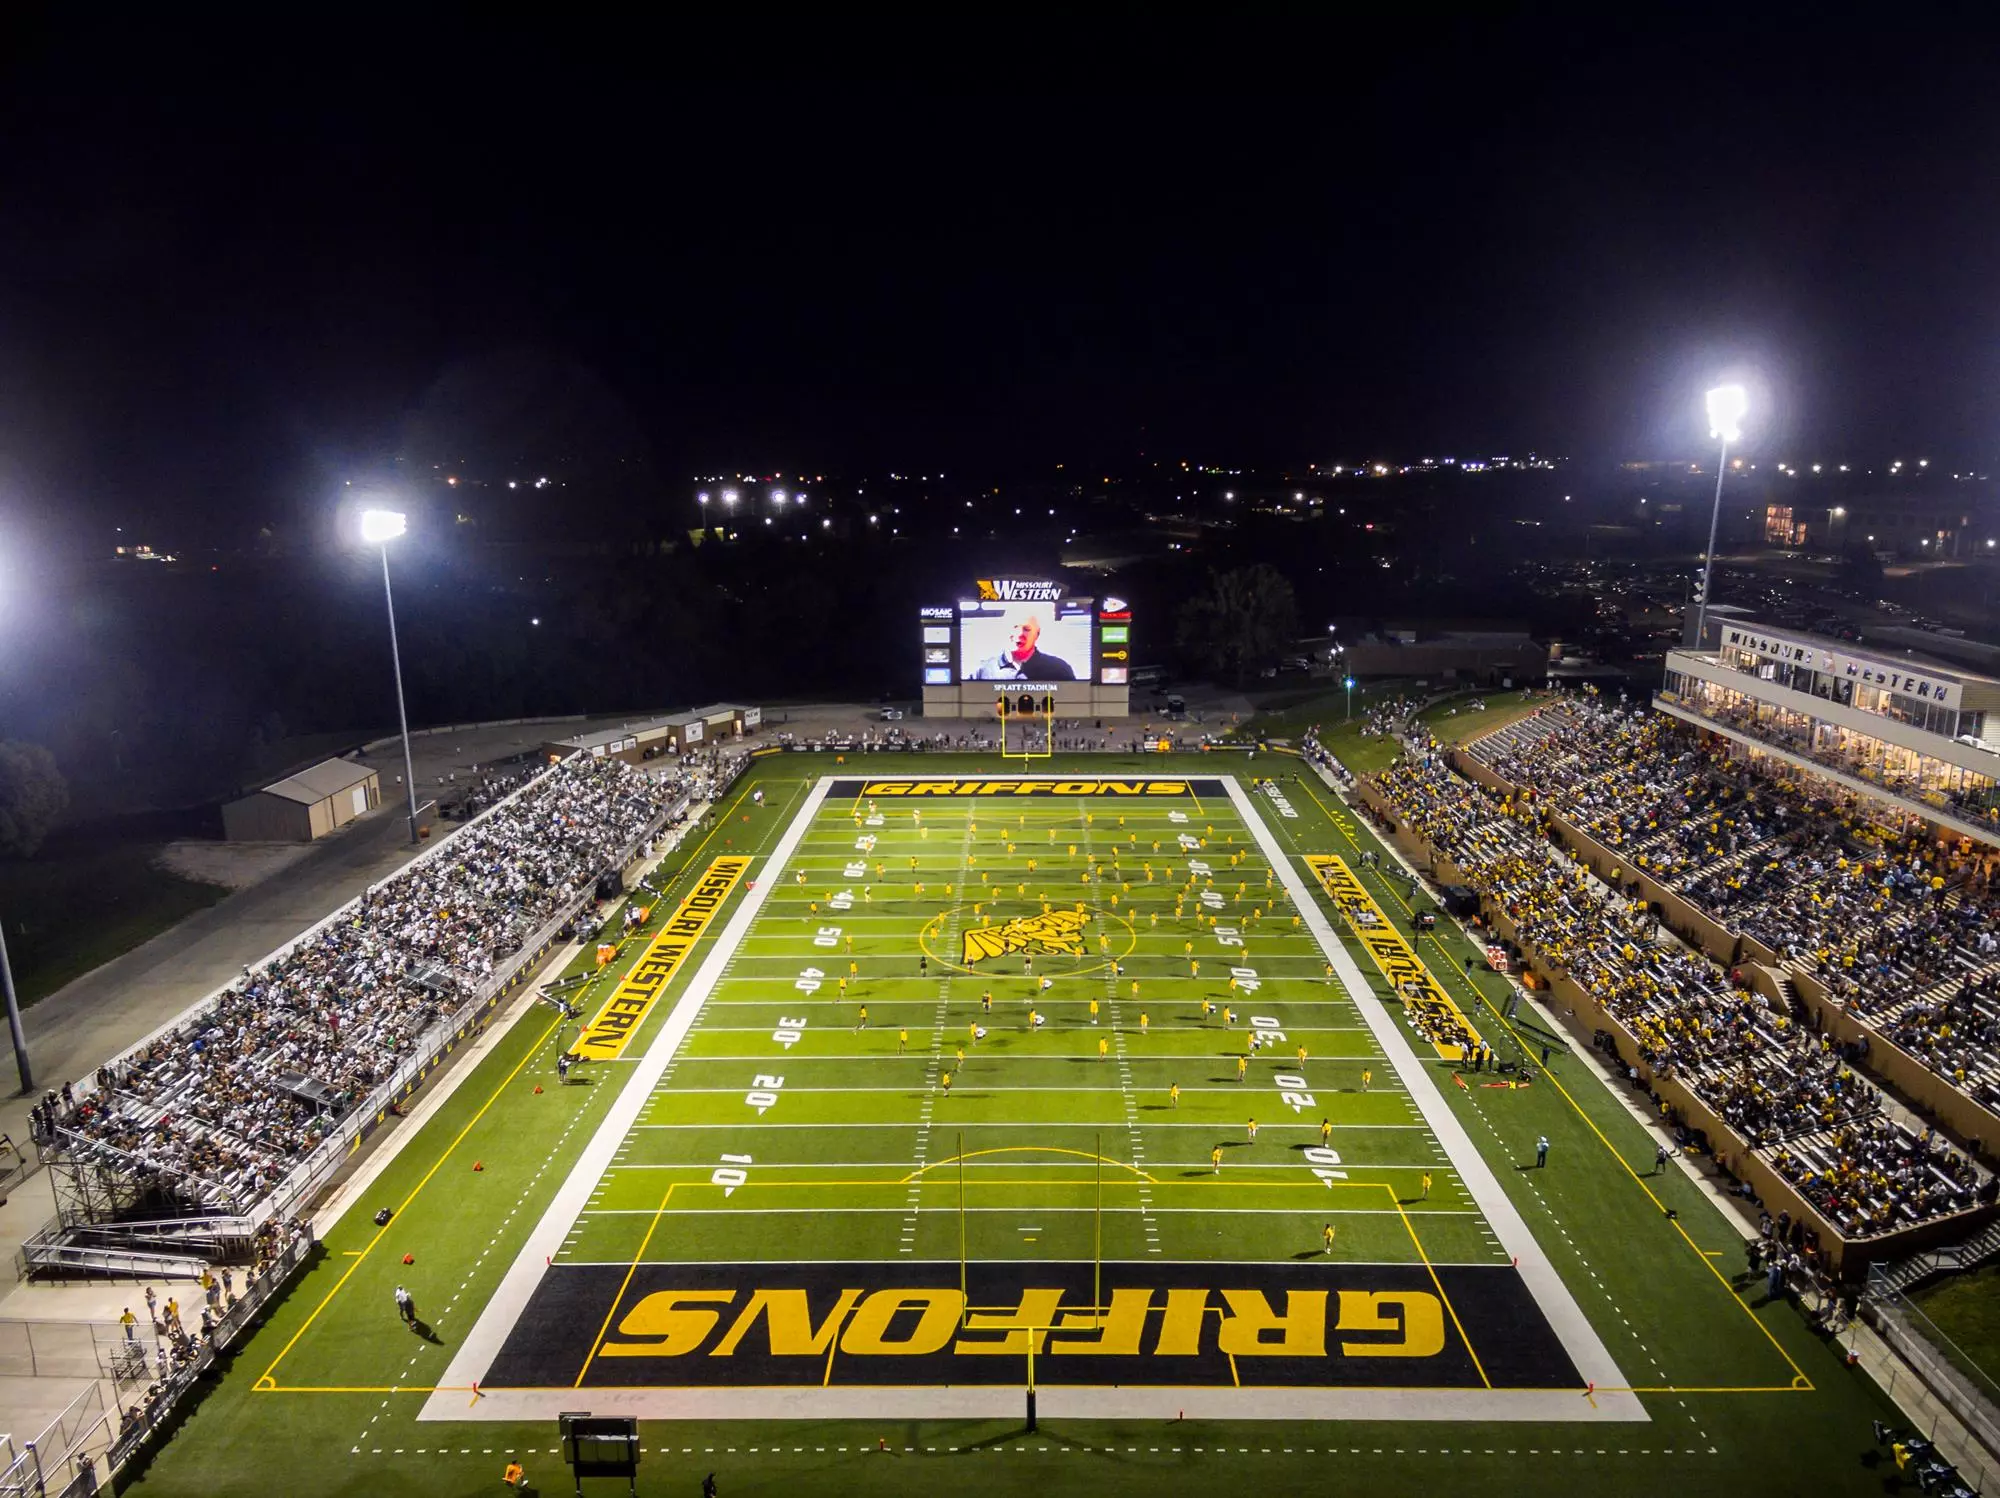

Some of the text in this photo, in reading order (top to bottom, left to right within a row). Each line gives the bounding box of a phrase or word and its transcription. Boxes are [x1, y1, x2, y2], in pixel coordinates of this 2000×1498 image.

[993, 580, 1062, 600] WESTERN
[1016, 581, 1053, 589] MISSOURI
[921, 608, 952, 616] MOSAIC
[993, 684, 1058, 692] SPRATT STADIUM
[864, 782, 1187, 796] GRIFFONS
[813, 927, 842, 946] 50
[1213, 927, 1245, 946] 50
[583, 861, 743, 1049] MISSOURI WESTERN
[795, 967, 825, 990] 40
[1230, 967, 1262, 991] 40
[772, 1016, 807, 1042] 30
[1250, 1016, 1287, 1043] 30
[745, 1074, 785, 1107] 20
[1273, 1075, 1316, 1107] 20
[711, 1153, 752, 1186] 10
[1303, 1148, 1349, 1180] 10
[598, 1289, 1445, 1357] GRIFFONS
